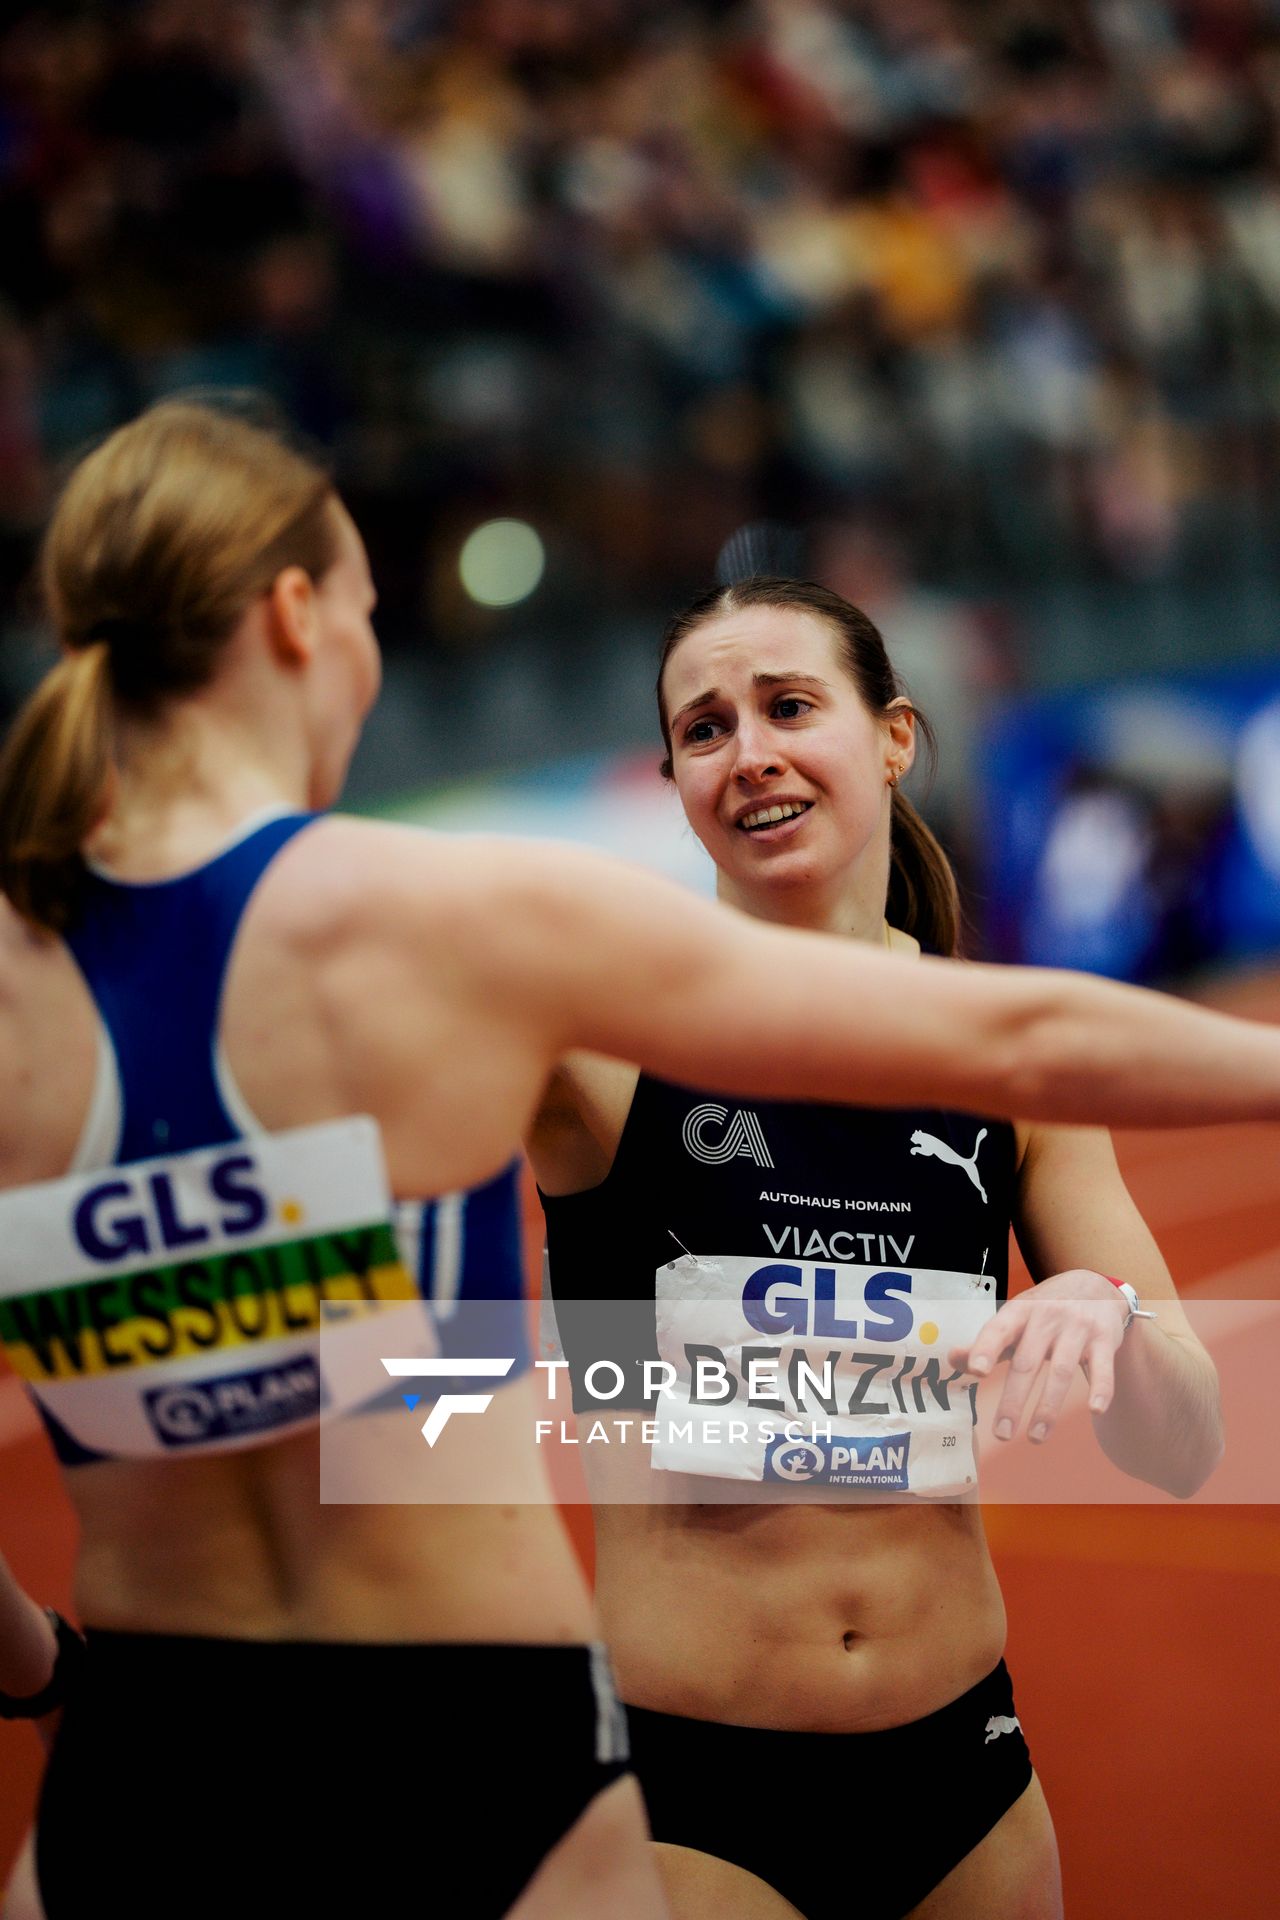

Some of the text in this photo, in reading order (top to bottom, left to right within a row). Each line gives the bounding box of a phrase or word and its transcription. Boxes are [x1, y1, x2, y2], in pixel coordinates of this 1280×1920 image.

[759, 1191, 912, 1213] AUTOHAUS HOMANN
[762, 1223, 916, 1264] VIACTIV
[9, 1229, 384, 1377] WESSOLLY
[683, 1344, 979, 1427] BENZIN
[941, 1435, 956, 1448] 320
[829, 1446, 905, 1471] PLAN
[829, 1475, 903, 1485] INTERNATIONAL
